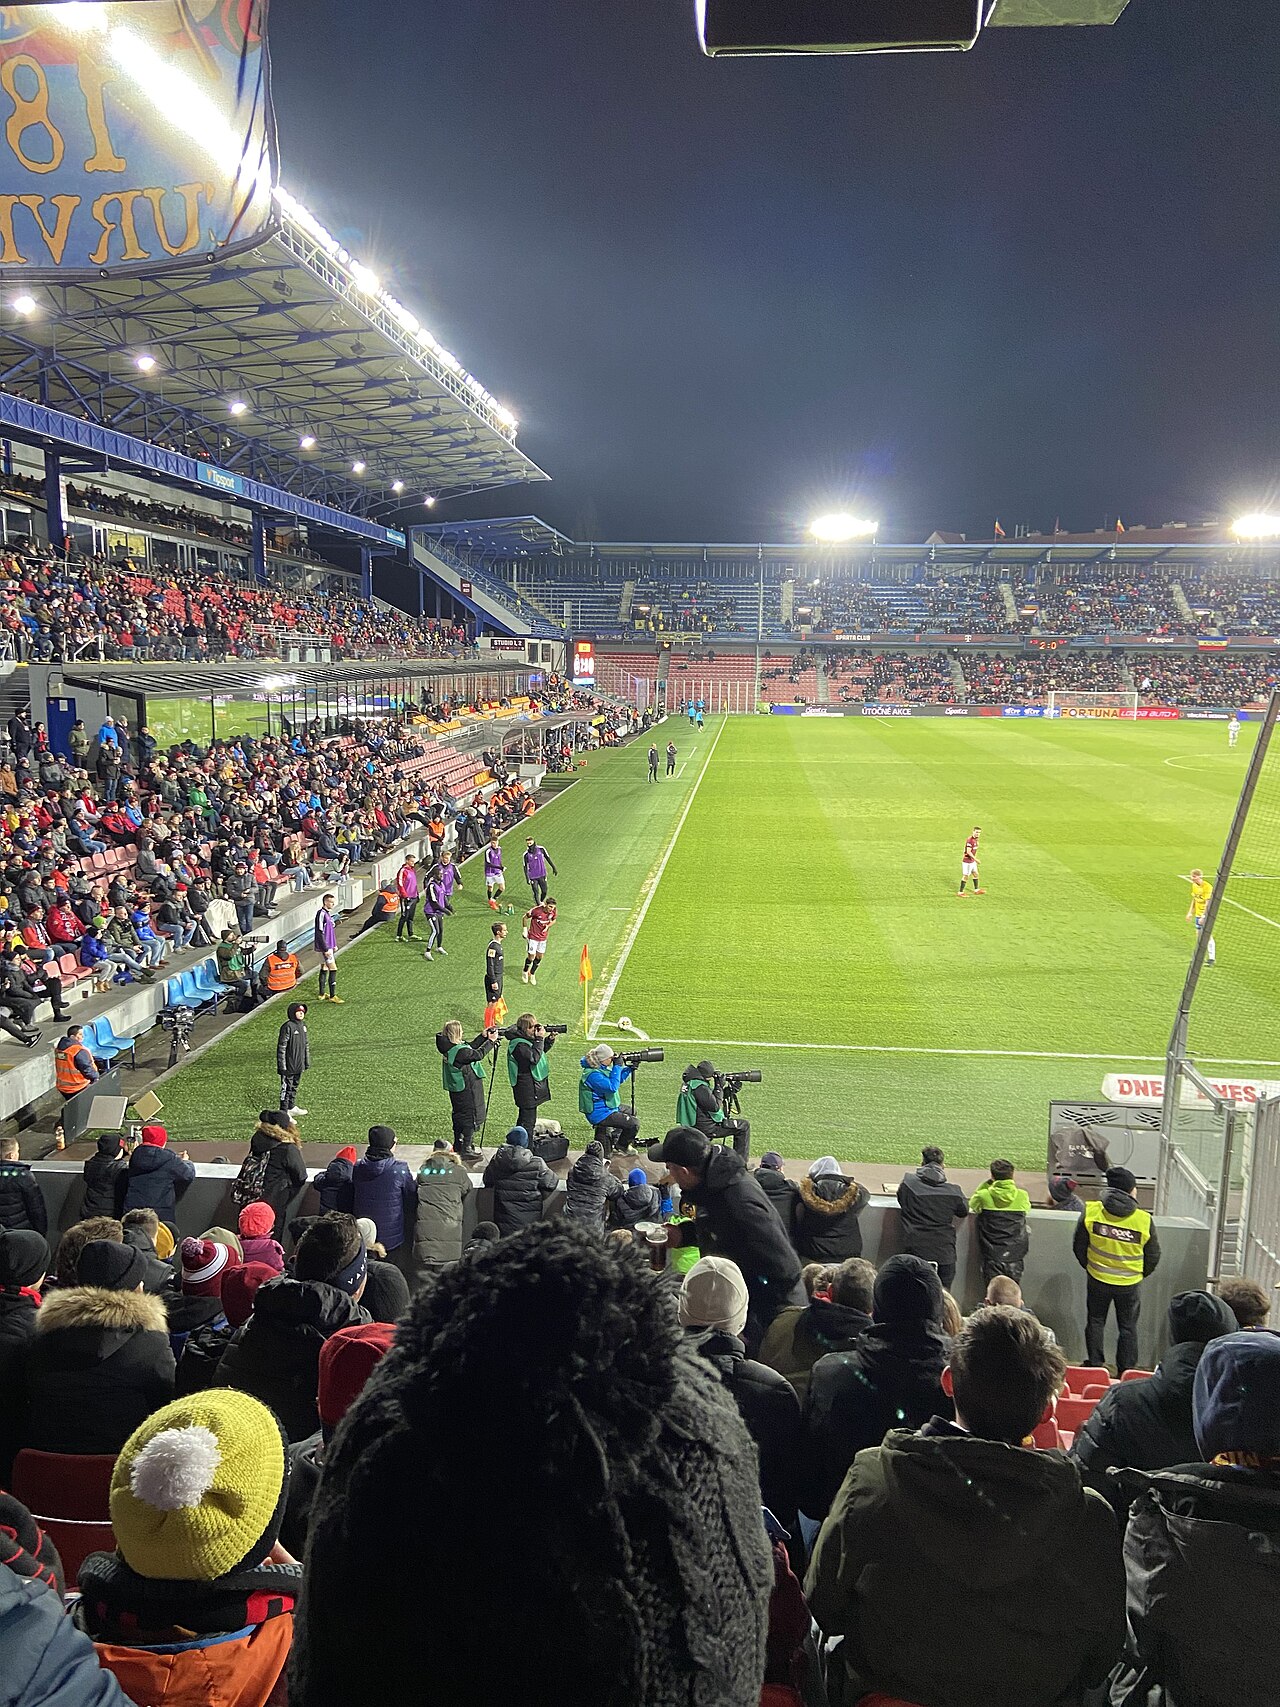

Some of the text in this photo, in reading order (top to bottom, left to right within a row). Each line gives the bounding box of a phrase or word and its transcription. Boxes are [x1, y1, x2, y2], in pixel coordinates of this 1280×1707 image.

[892, 707, 912, 716] AKCE
[1060, 708, 1119, 718] FORTUNA
[1118, 1079, 1165, 1097] DNE
[1197, 1083, 1258, 1104] NES
